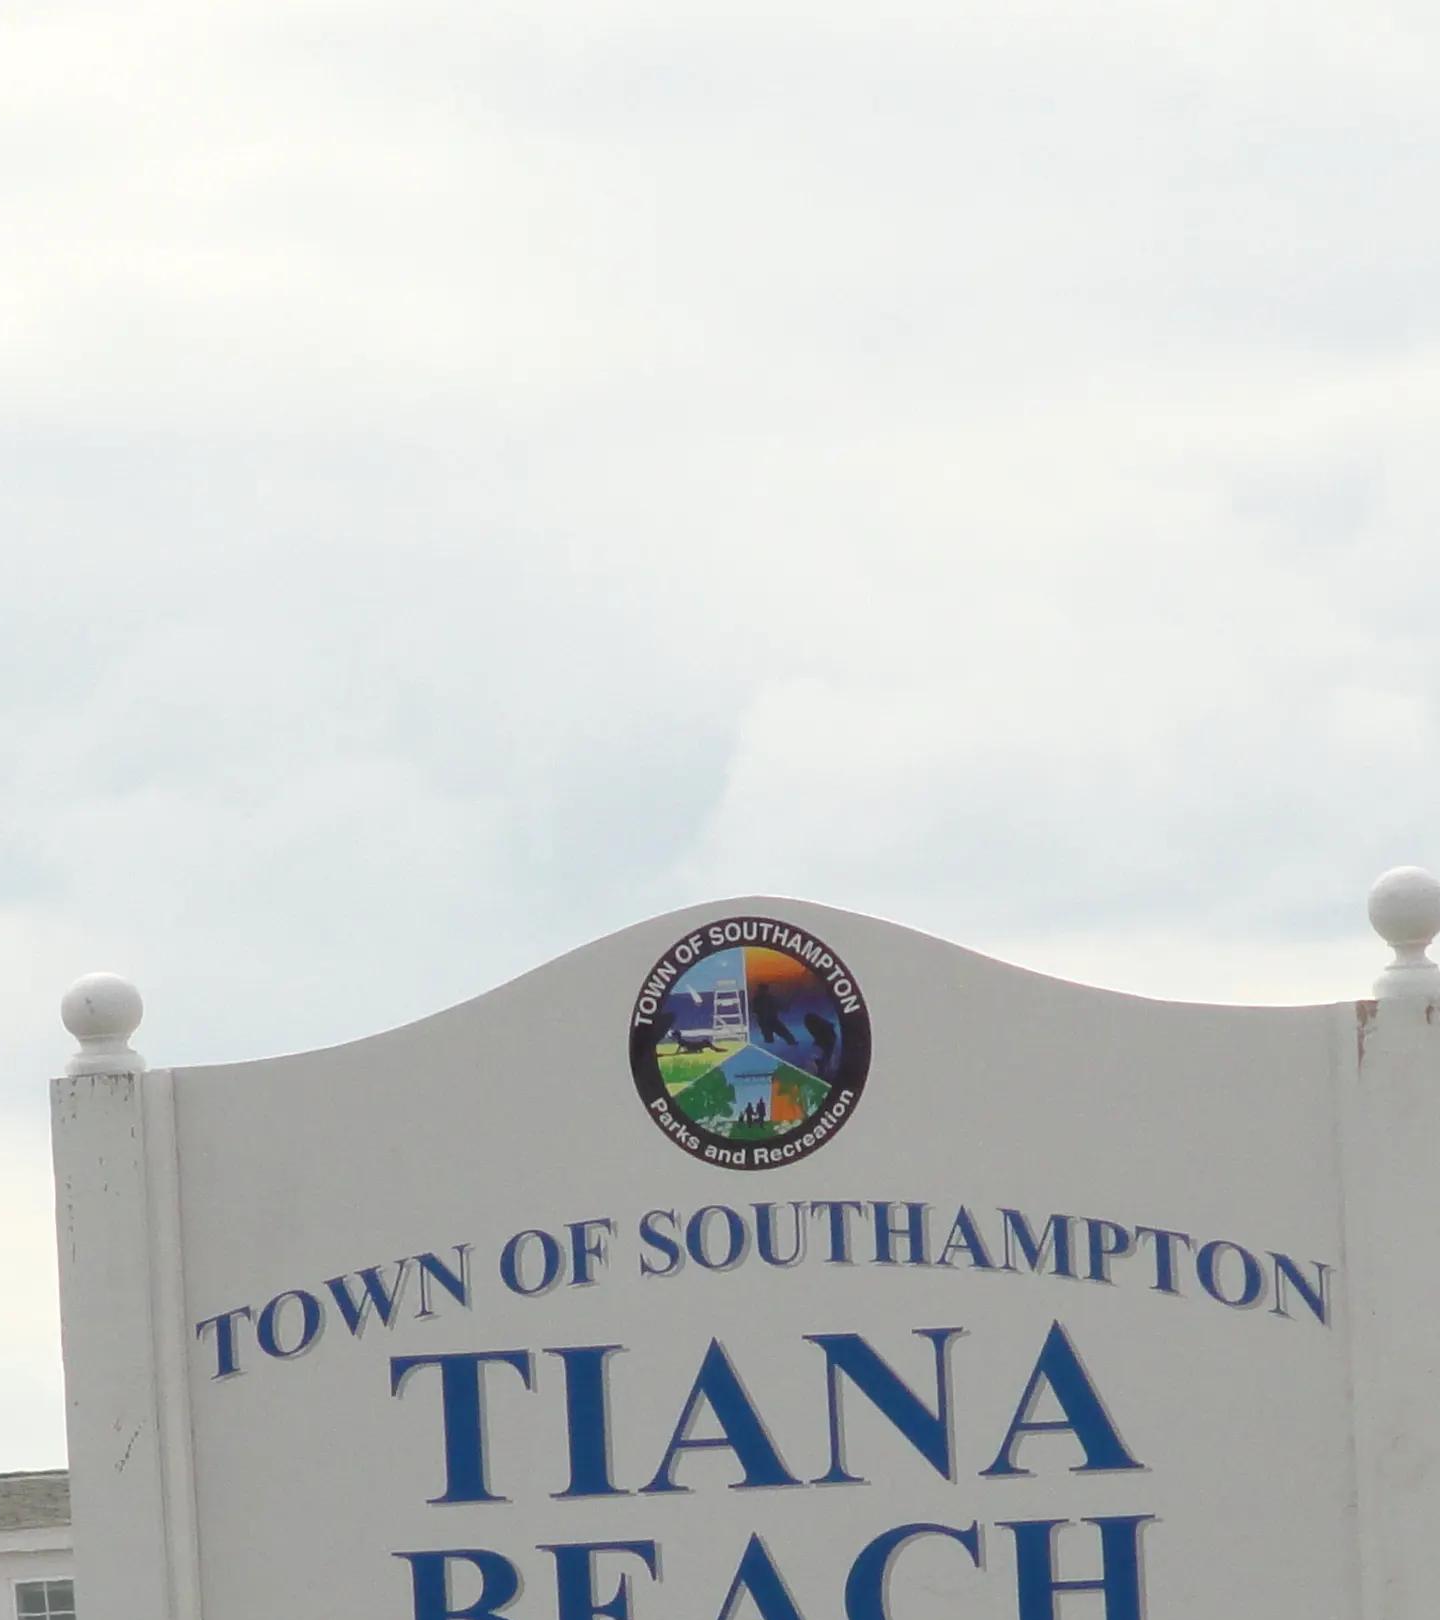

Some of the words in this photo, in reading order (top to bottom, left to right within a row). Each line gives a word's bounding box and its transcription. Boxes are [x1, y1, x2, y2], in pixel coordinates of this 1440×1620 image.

[634, 961, 677, 1026] TOWN
[675, 934, 704, 965] OF
[709, 921, 860, 1014] SOUTHAMPTON
[650, 1097, 700, 1151] Parks
[704, 1143, 746, 1165] and
[753, 1088, 854, 1165] Recreation
[195, 1243, 471, 1381] TOWN
[498, 1218, 615, 1296] OF
[638, 1201, 1332, 1326] SOUTHAMPTON
[390, 1320, 1147, 1505] TIANA
